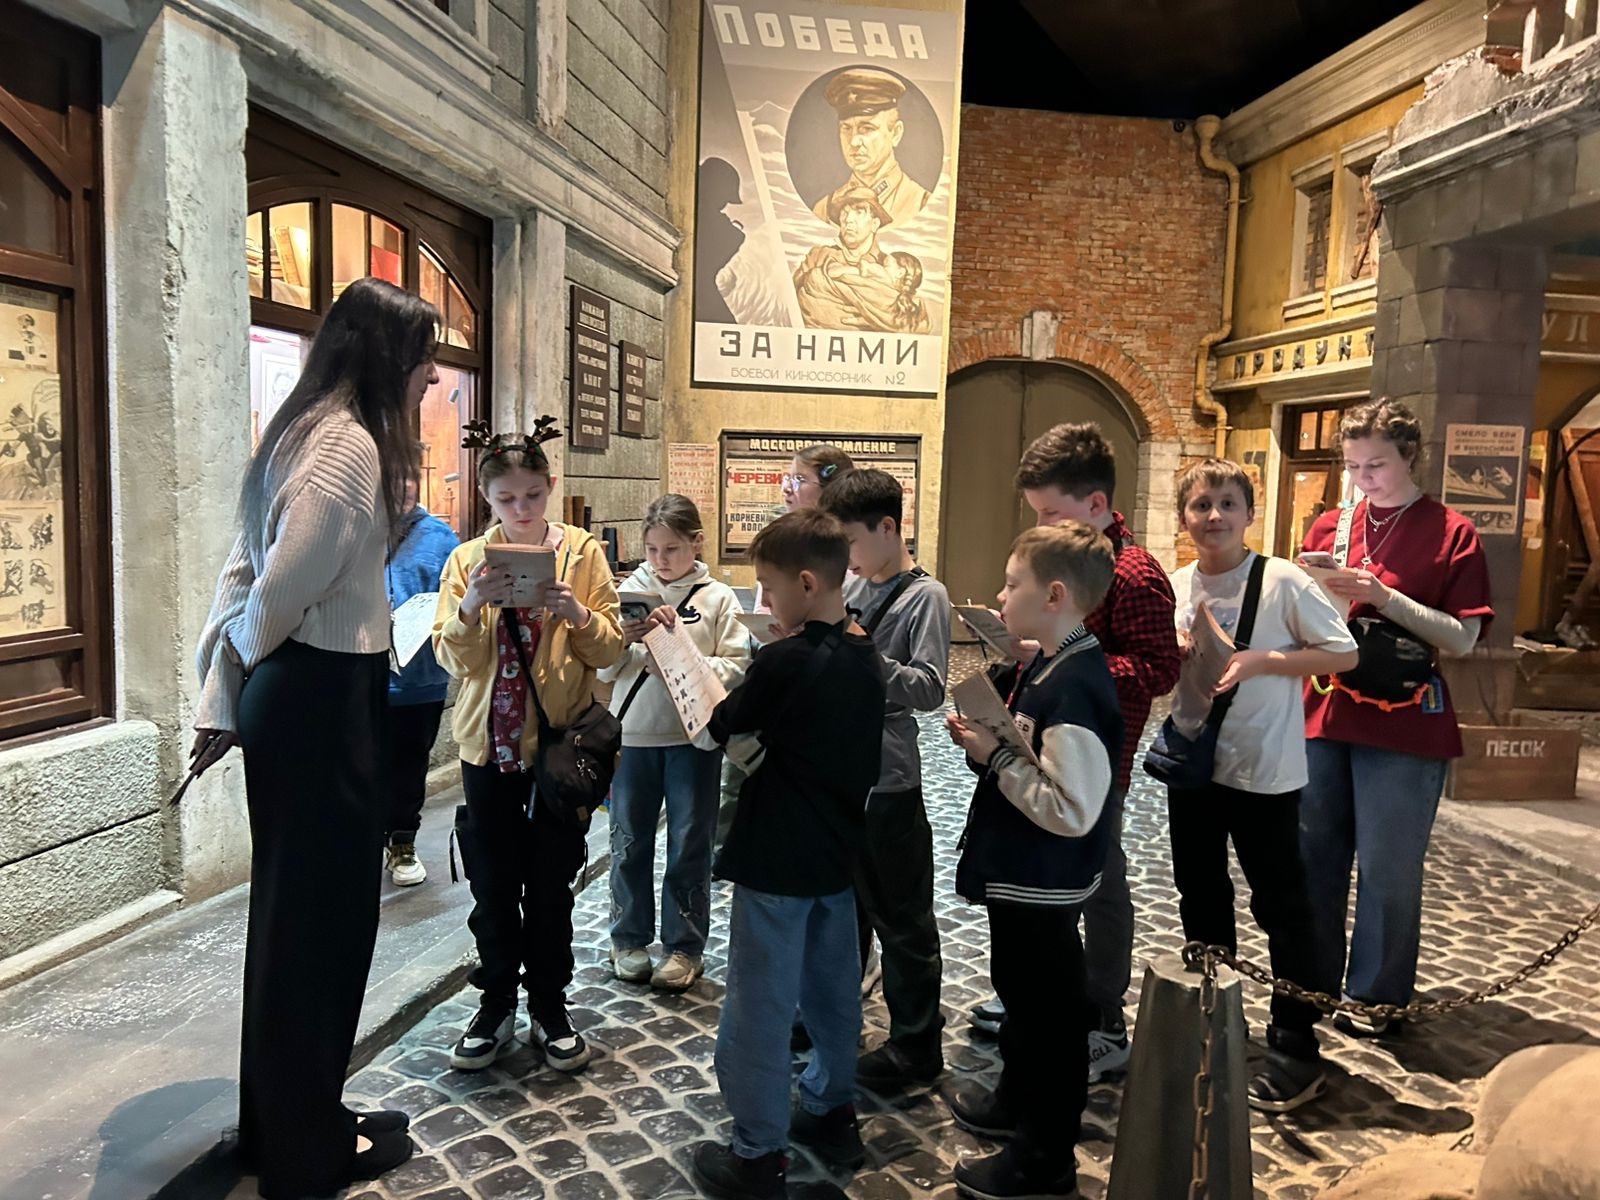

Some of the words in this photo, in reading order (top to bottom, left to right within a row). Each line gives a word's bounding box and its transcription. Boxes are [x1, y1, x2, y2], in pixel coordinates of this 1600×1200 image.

[712, 4, 929, 60] ПОБЕДА
[720, 330, 772, 359] ЗА
[797, 334, 919, 366] НАМИ
[785, 370, 872, 384] КИНОСБОРНИК
[1455, 429, 1488, 438] СМЕЛО
[730, 472, 783, 485] ЧЕРЕВИ
[730, 512, 766, 523] КОРНЕВИ
[741, 522, 763, 532] КОЛО
[1486, 740, 1545, 758] ПЕСОК
